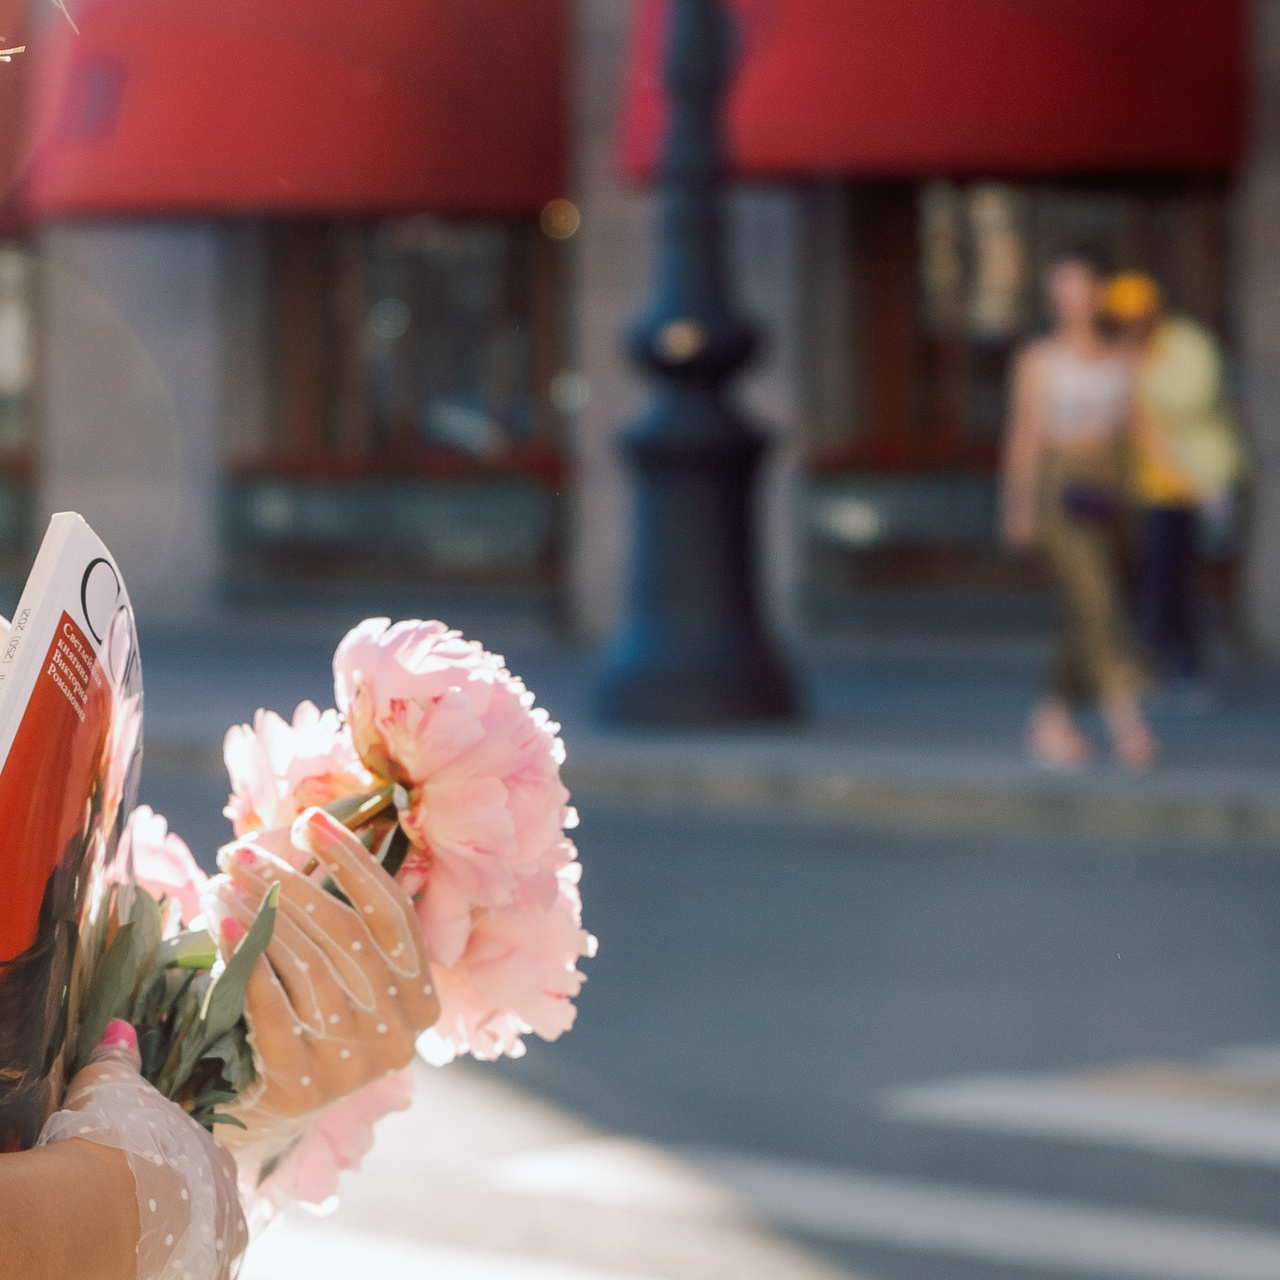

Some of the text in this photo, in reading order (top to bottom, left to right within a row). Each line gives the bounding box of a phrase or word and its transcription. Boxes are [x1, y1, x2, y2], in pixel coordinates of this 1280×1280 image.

[15, 608, 31, 631] 2021
[52, 648, 88, 704] Виктория
[57, 638, 89, 684] княгиня
[46, 662, 86, 723] Романовна
